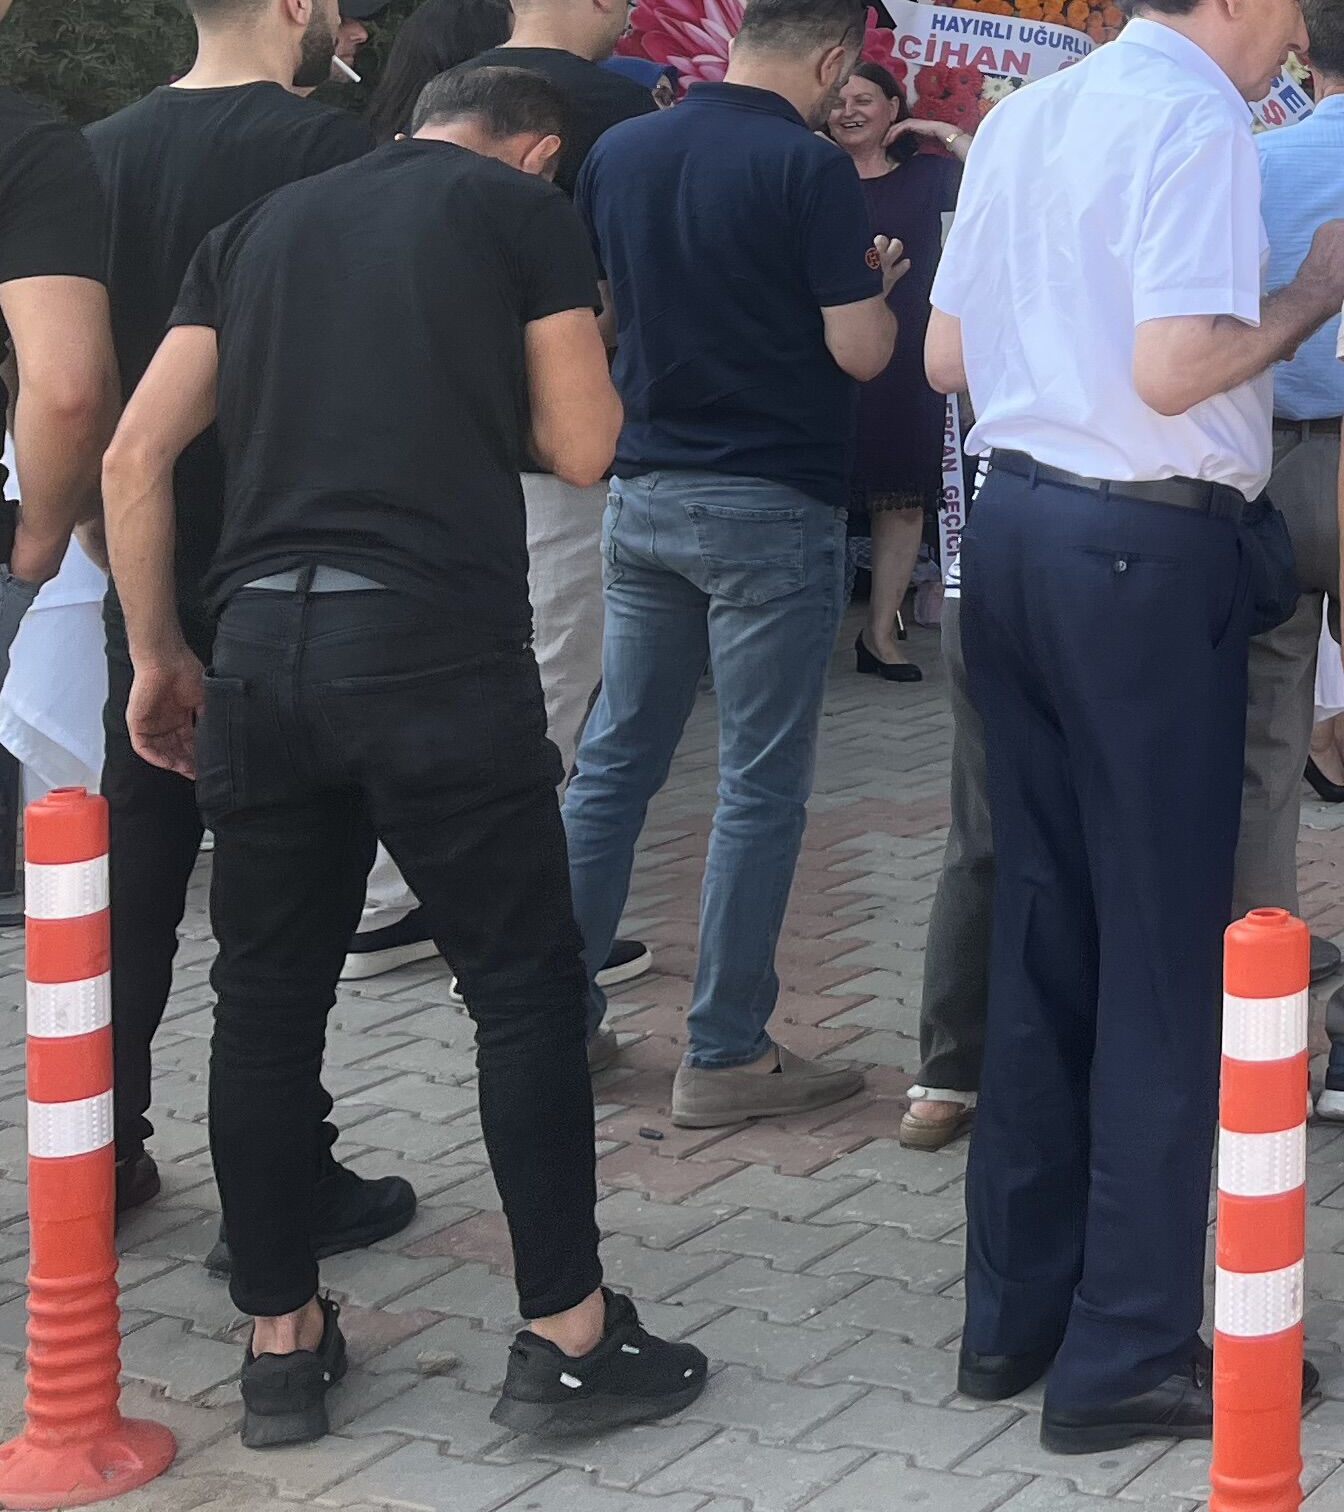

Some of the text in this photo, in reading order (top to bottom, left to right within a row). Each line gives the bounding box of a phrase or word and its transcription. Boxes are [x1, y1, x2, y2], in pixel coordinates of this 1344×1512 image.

[898, 33, 1032, 75] CİHAN
[931, 13, 1092, 57] HAYIRLI UĞURLU
